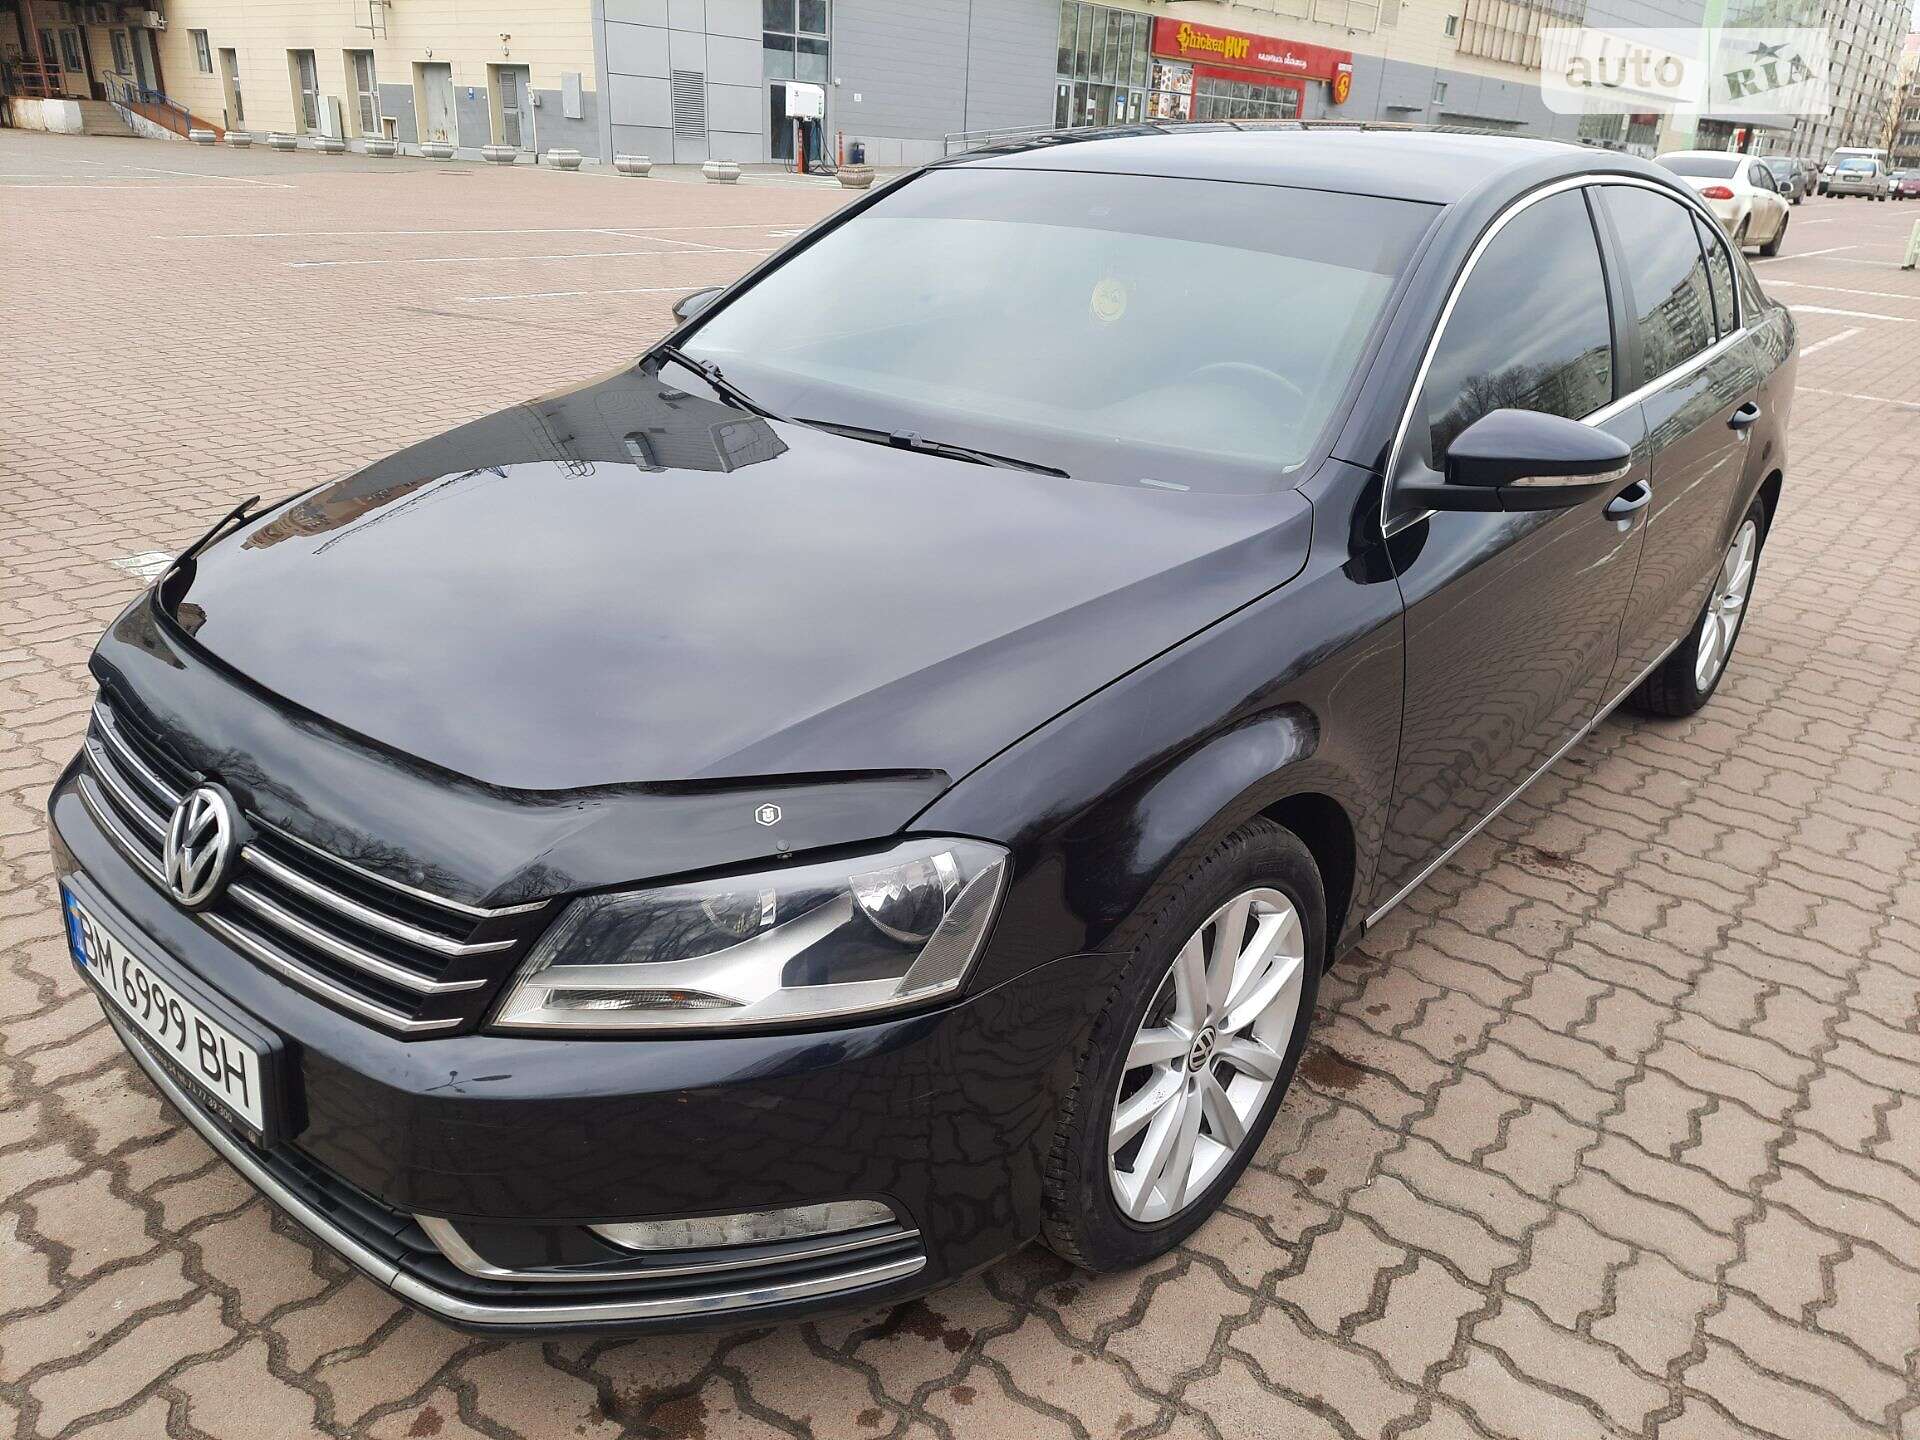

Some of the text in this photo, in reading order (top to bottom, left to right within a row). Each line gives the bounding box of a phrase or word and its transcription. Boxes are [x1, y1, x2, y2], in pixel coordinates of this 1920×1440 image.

[1224, 35, 1250, 58] HUT
[79, 907, 250, 1108] BM 6999 BH
